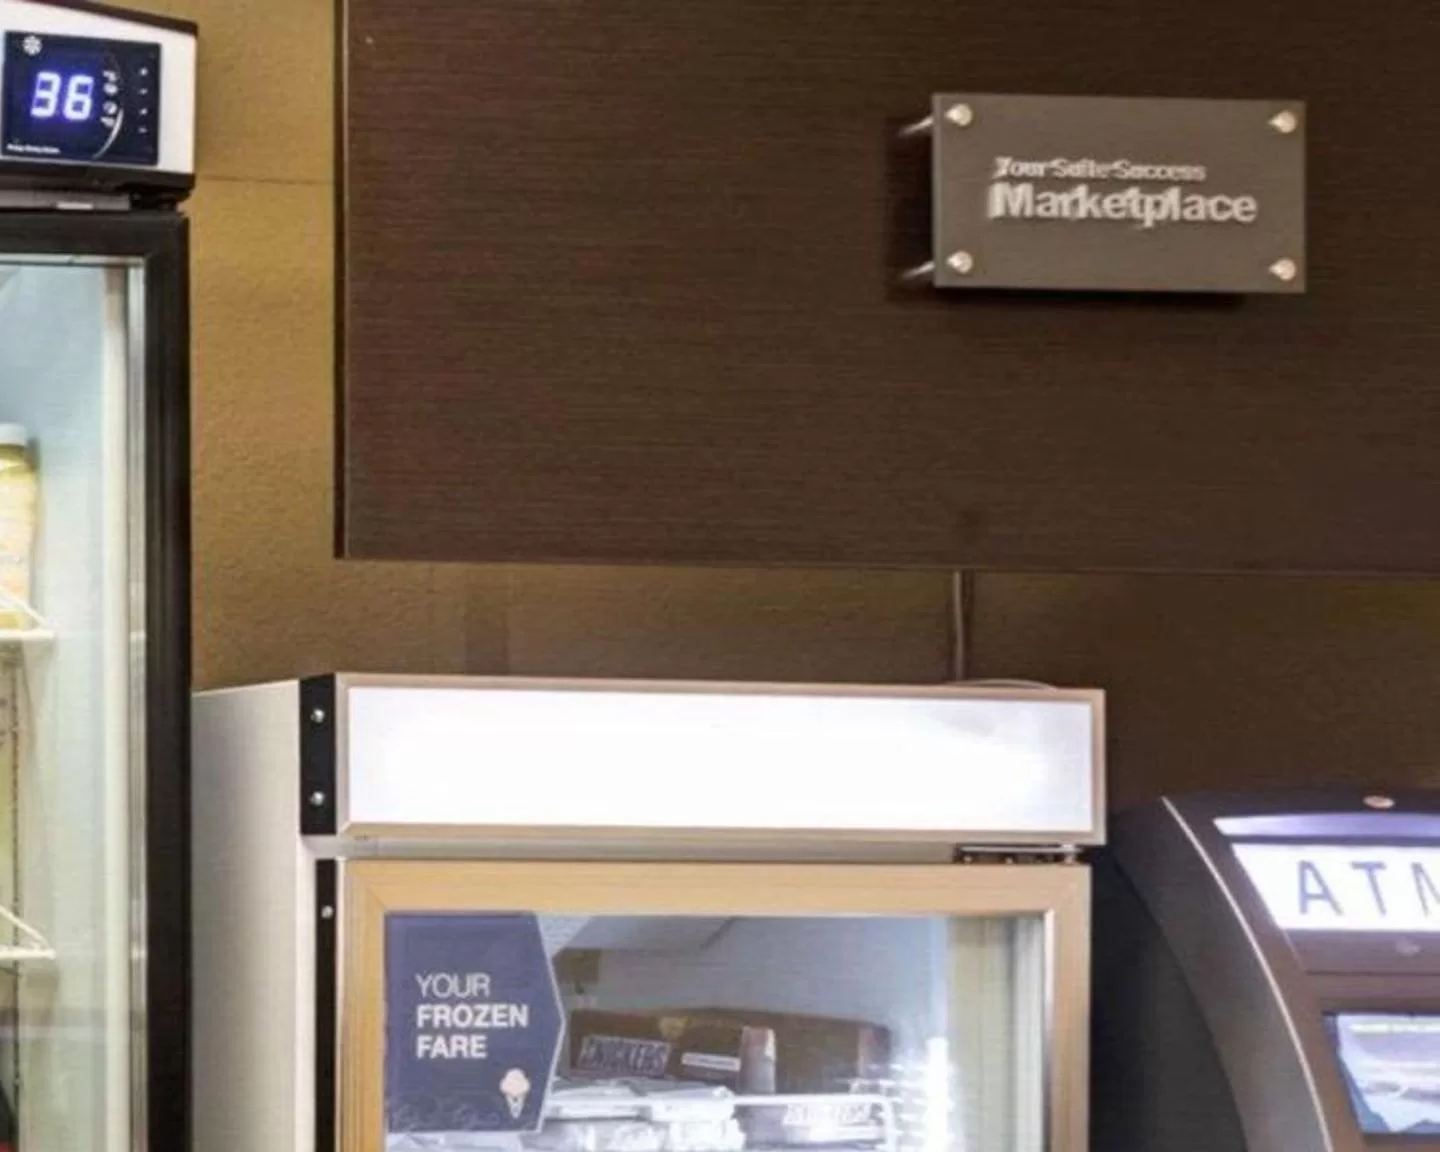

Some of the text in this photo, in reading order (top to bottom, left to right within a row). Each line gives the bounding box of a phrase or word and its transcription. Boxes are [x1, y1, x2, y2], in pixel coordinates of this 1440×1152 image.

[31, 71, 94, 120] 36
[988, 181, 1257, 229] Marketplace
[1298, 858, 1440, 918] ATM
[415, 972, 491, 998] YOUR
[416, 1003, 529, 1028] FROZEN
[416, 1034, 488, 1059] FARE
